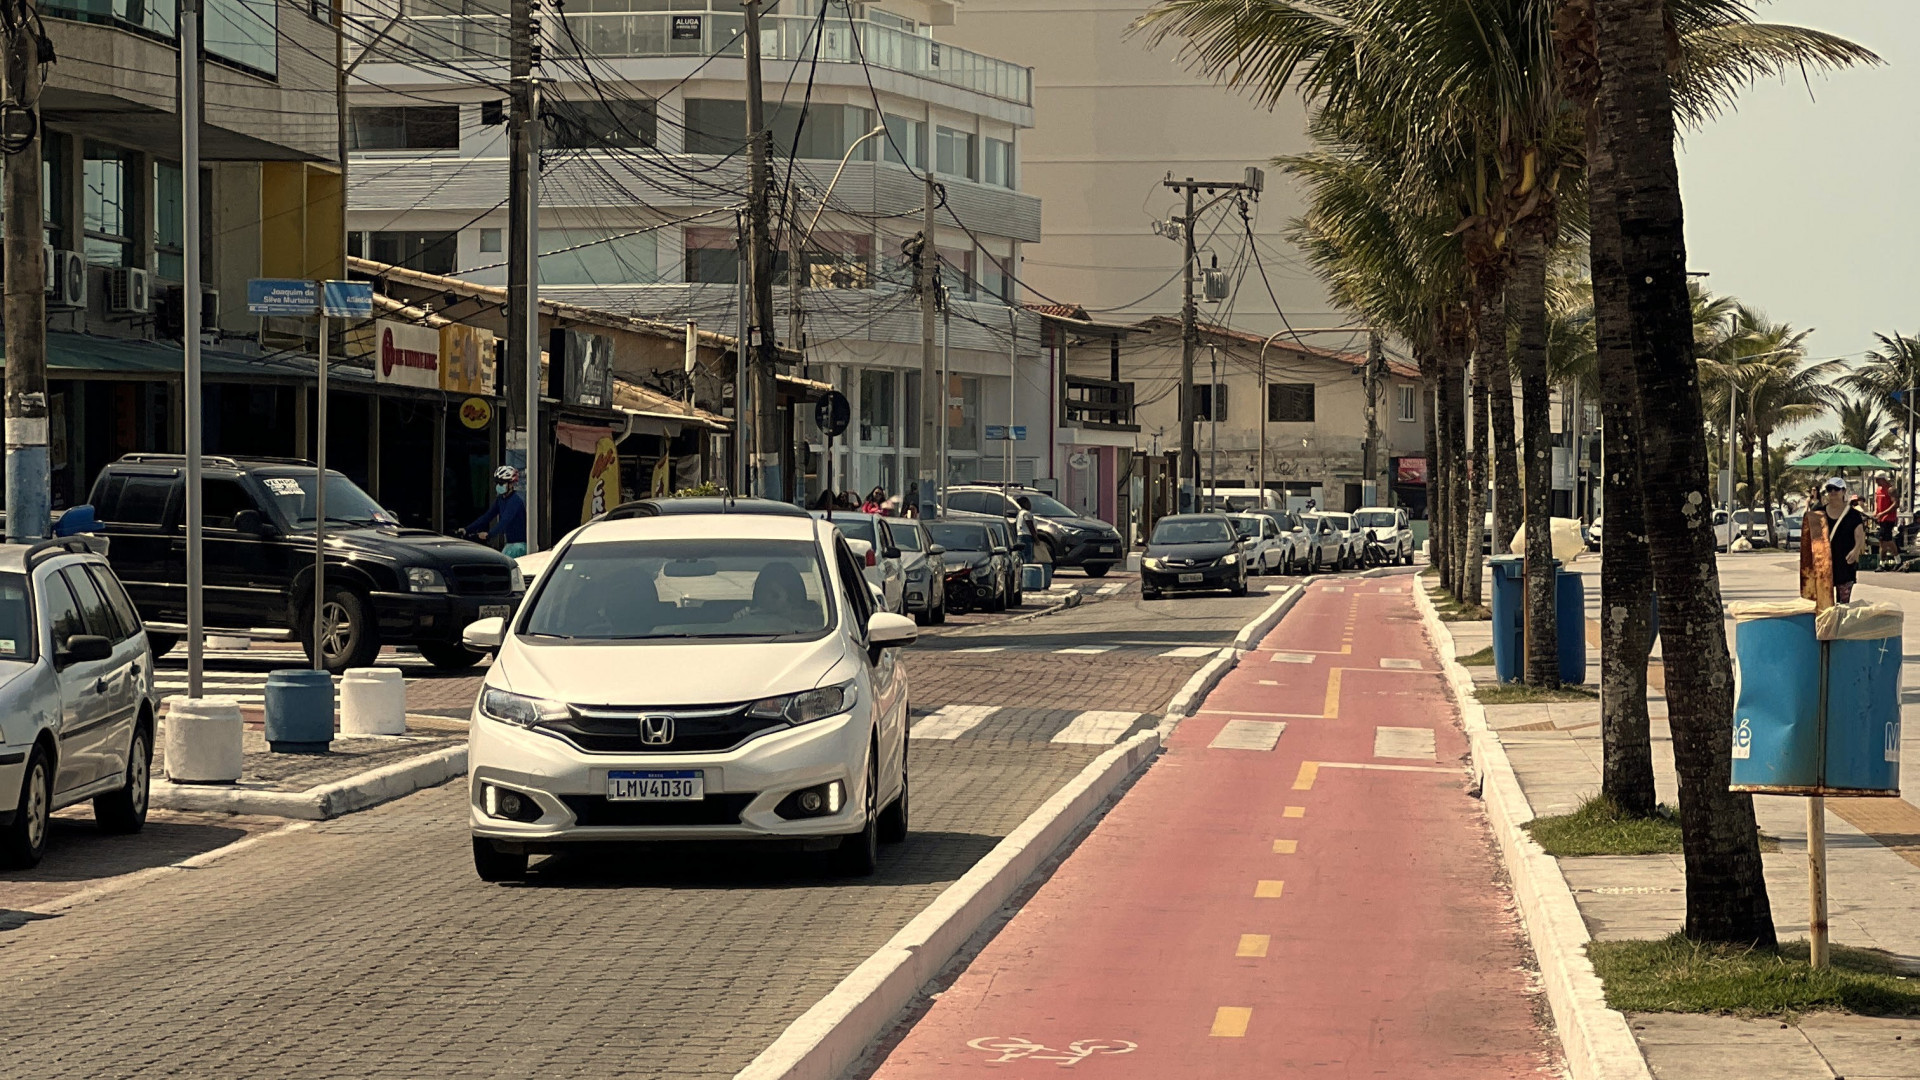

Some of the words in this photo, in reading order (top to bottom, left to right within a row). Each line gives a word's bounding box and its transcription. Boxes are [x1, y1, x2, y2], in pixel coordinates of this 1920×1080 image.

[271, 288, 303, 297] Joaquim
[283, 296, 314, 304] Murteira
[616, 780, 692, 797] LMV4D30
